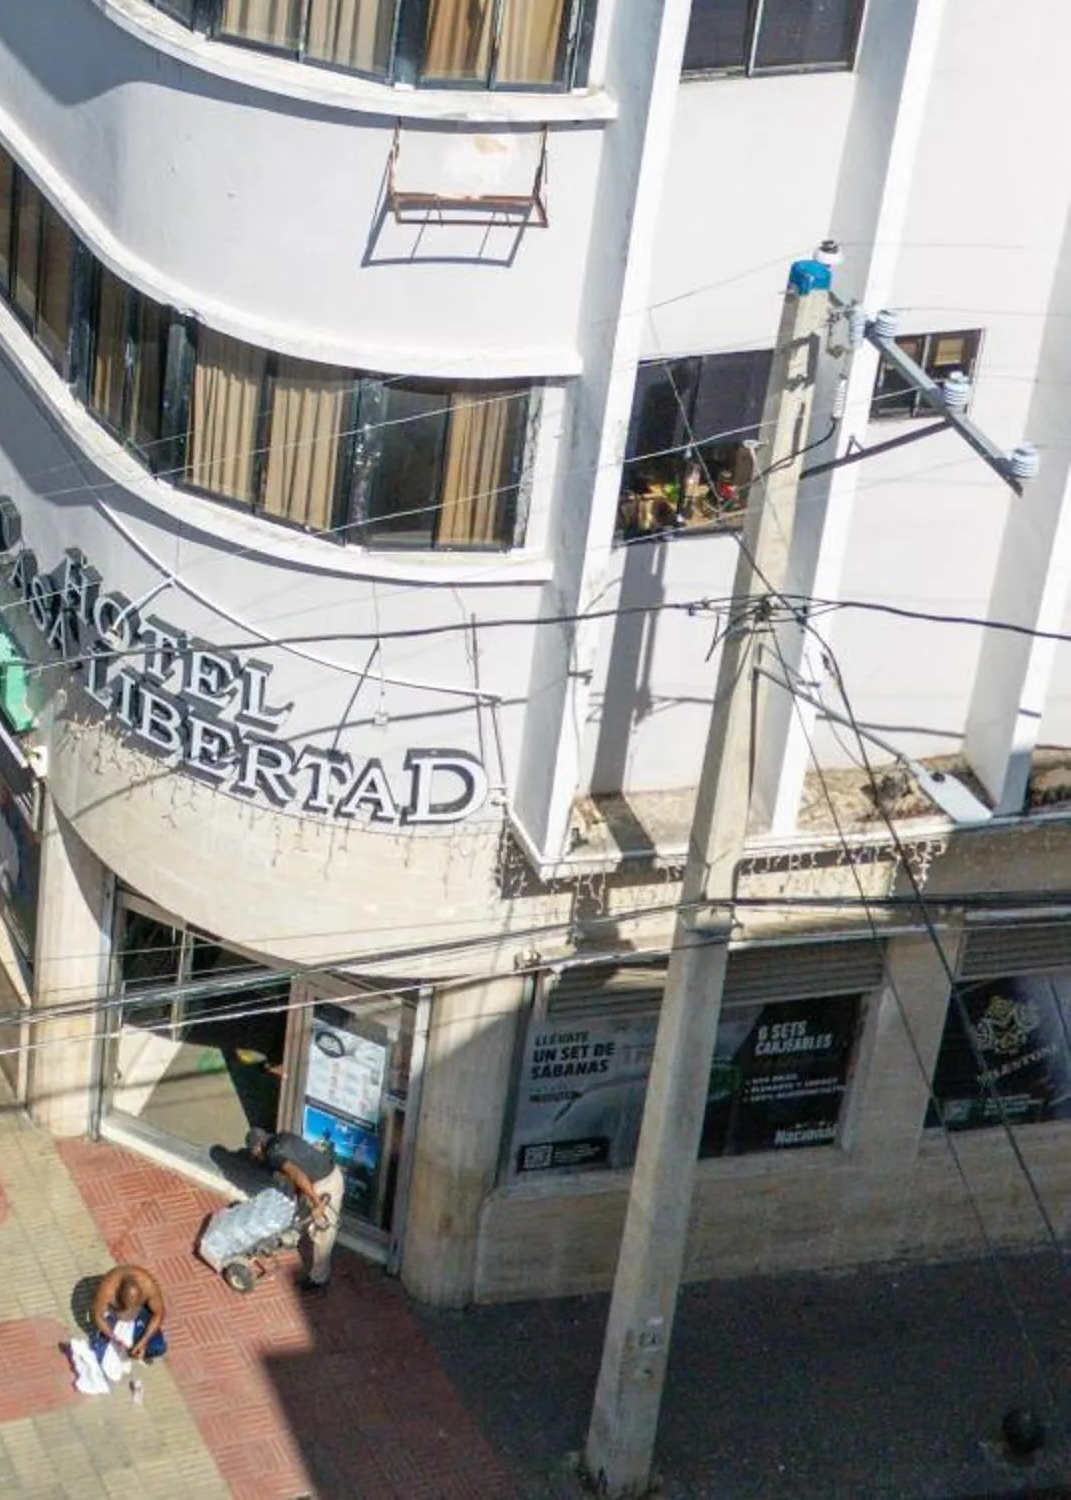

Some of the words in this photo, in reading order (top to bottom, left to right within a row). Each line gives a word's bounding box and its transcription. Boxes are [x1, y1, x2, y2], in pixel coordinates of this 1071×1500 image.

[62, 550, 294, 733] HOTEL
[84, 644, 489, 827] LIBERTAD
[532, 1049, 557, 1063] UN
[560, 1045, 590, 1061] SET
[593, 1041, 617, 1057] DE
